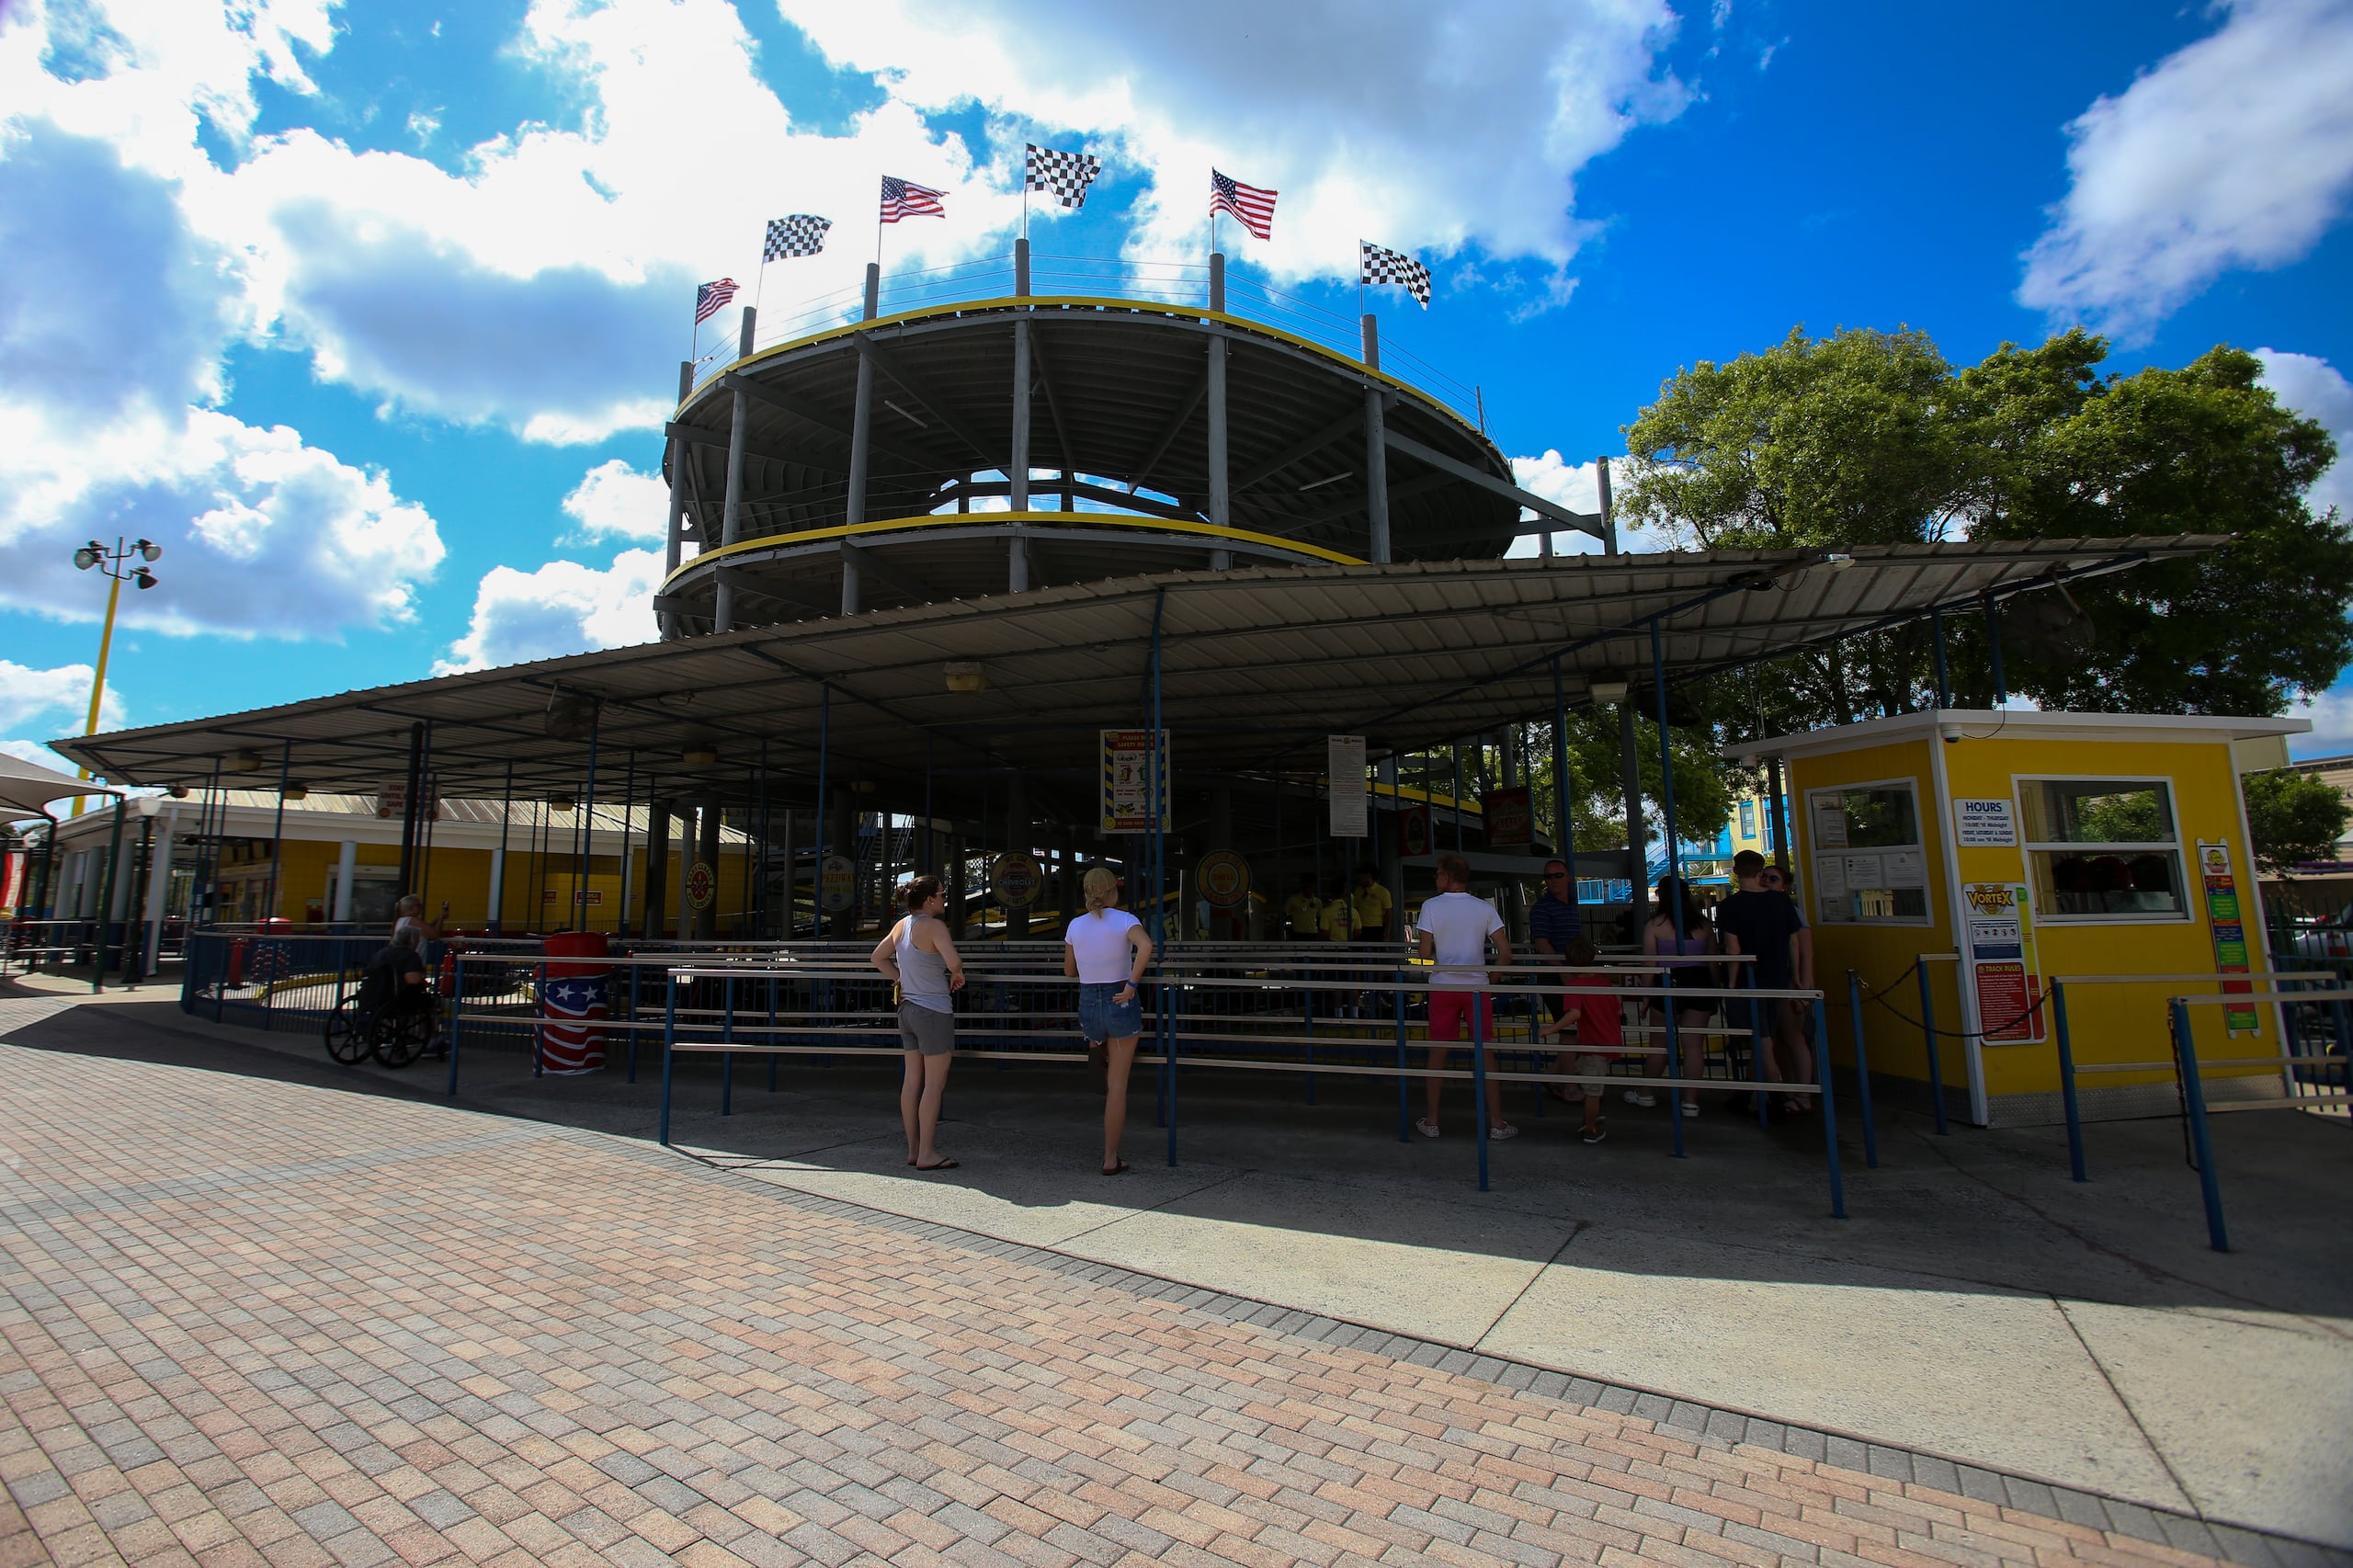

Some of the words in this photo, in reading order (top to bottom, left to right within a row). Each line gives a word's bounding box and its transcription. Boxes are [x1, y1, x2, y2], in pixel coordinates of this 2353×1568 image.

[1965, 801, 2002, 812] HOURS
[1203, 853, 1230, 869] MOTOR
[1230, 856, 1244, 868] OIL
[822, 873, 854, 883] PEEDWAY
[1965, 890, 2016, 911] VORTEX
